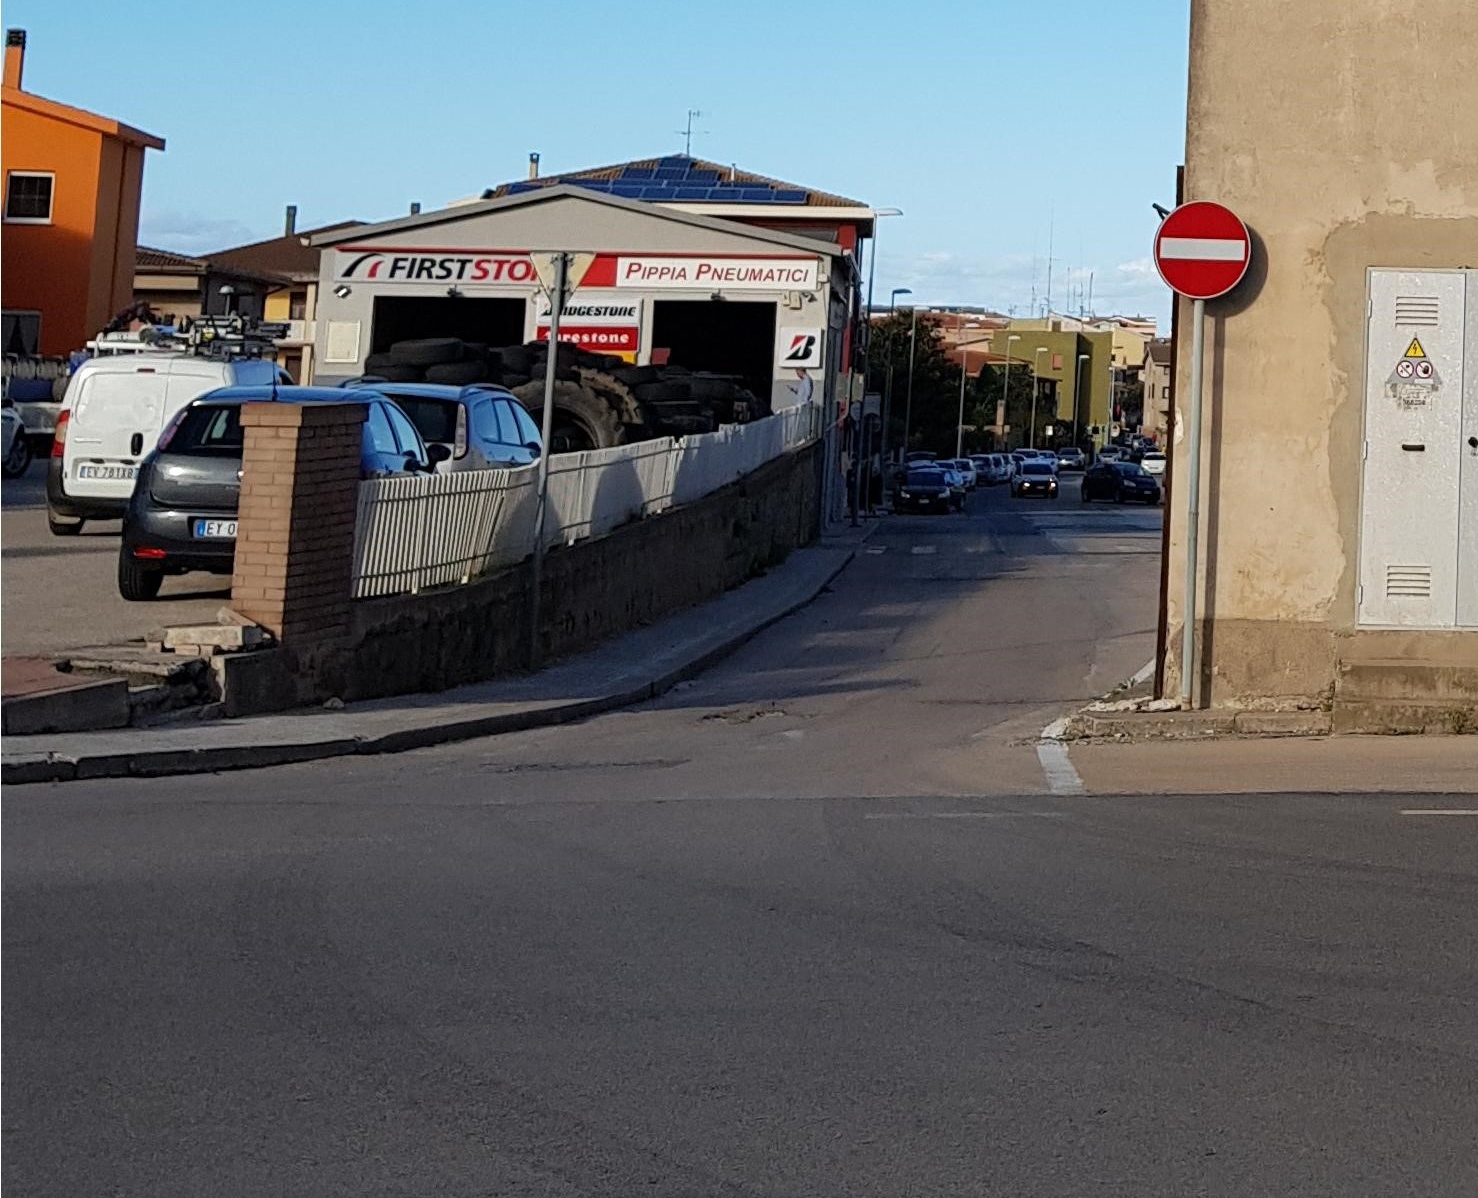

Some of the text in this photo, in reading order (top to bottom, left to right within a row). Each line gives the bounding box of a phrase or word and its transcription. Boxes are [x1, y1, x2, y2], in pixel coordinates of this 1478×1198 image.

[625, 262, 809, 283] PIPPIA PNEUMATICI
[206, 522, 225, 536] EY
